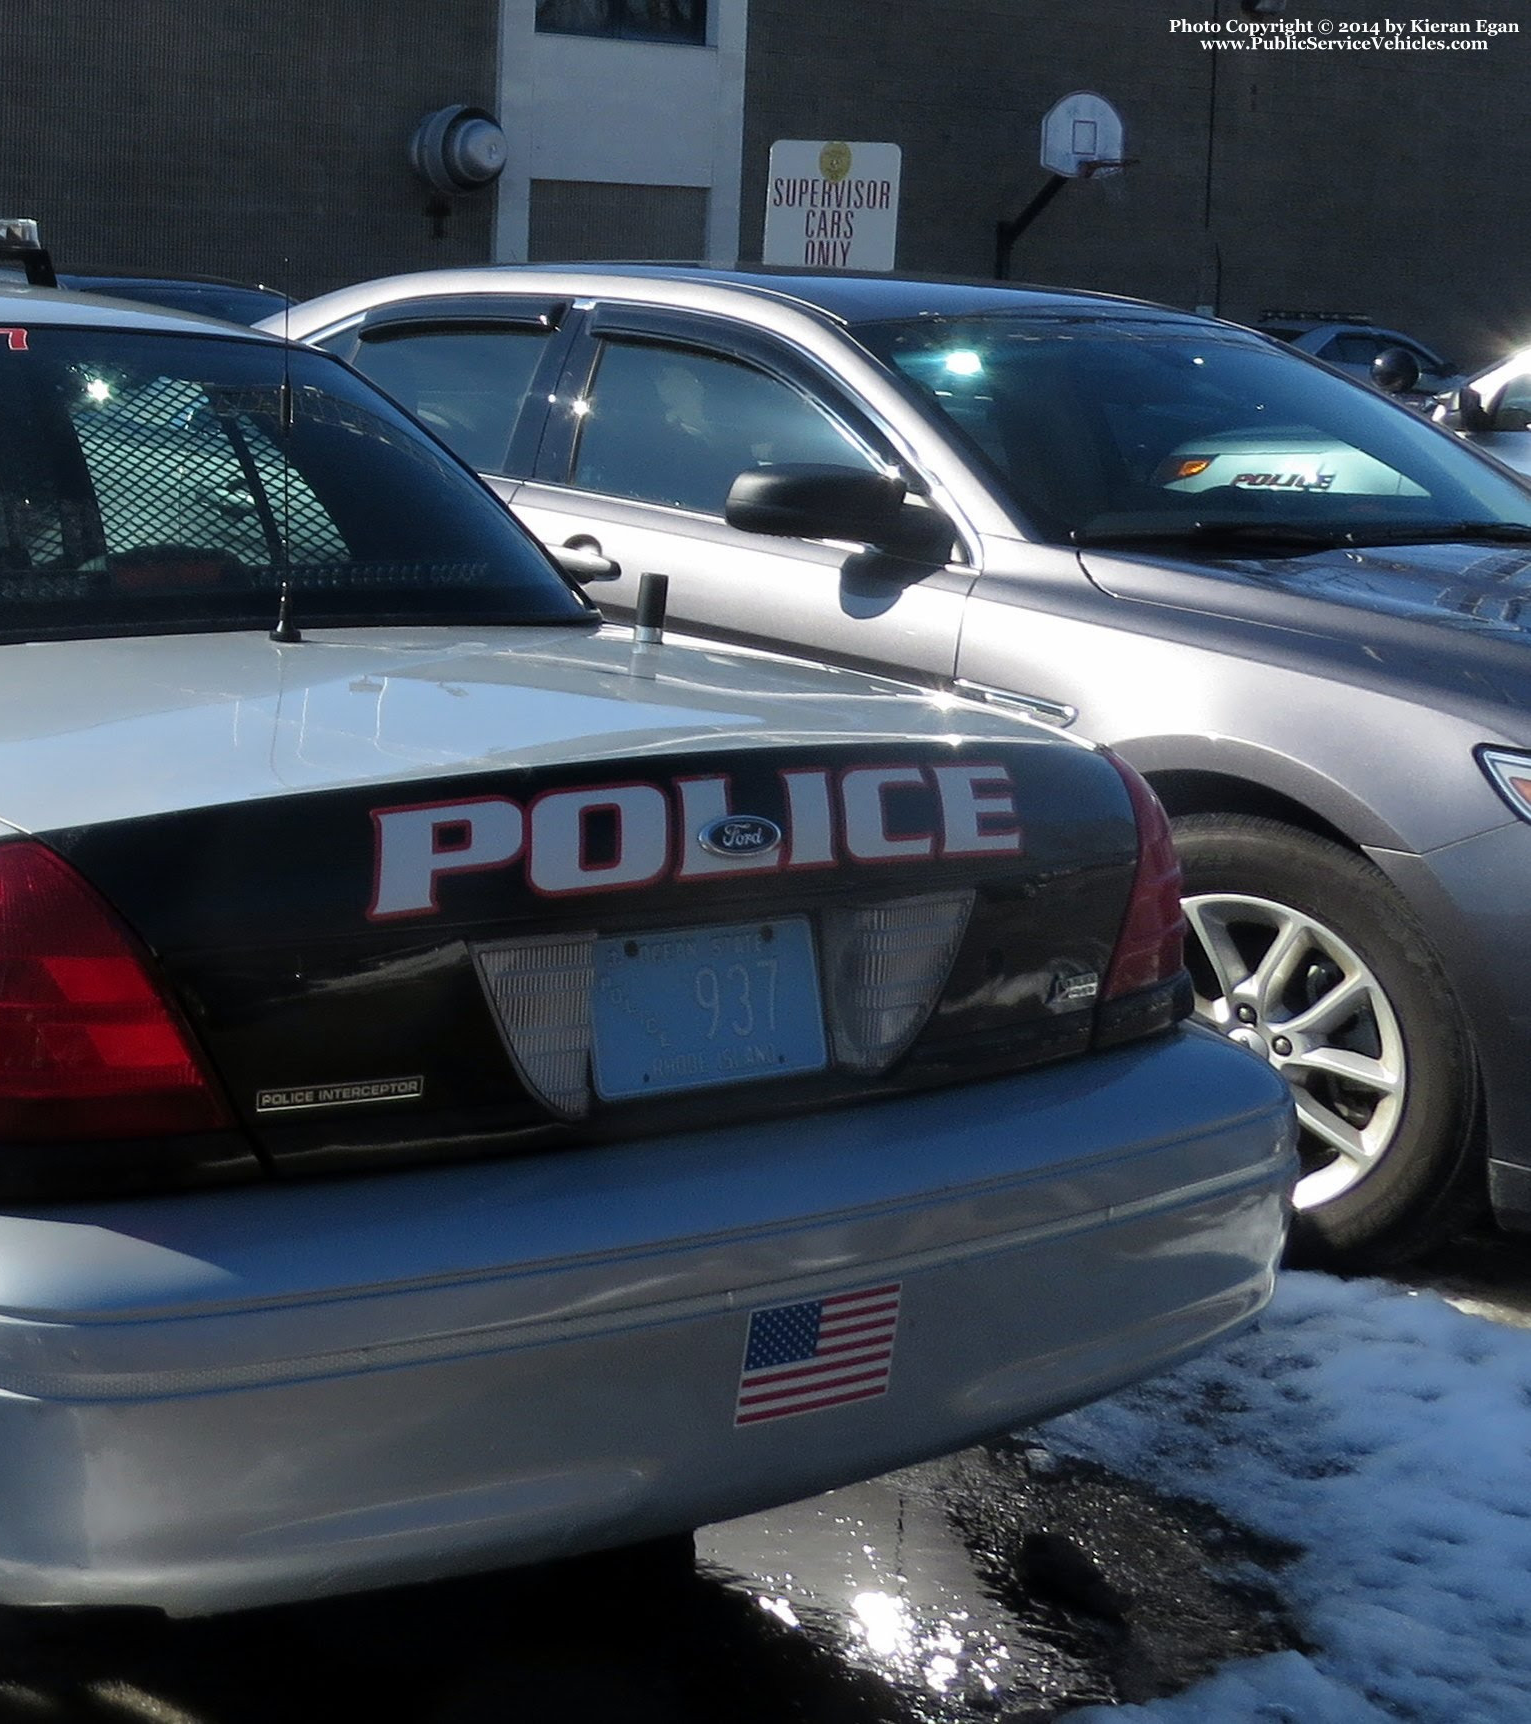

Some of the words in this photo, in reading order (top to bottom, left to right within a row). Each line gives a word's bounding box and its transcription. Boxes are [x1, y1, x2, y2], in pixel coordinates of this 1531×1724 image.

[773, 178, 891, 210] SUPERVISOR
[805, 209, 855, 239] CARS
[804, 240, 851, 267] ONLY
[366, 764, 1022, 920] POLICE
[722, 823, 762, 847] Ford
[695, 959, 779, 1041] 937
[261, 1091, 315, 1107] POLICE
[318, 1081, 419, 1102] INTERCEPTOR
